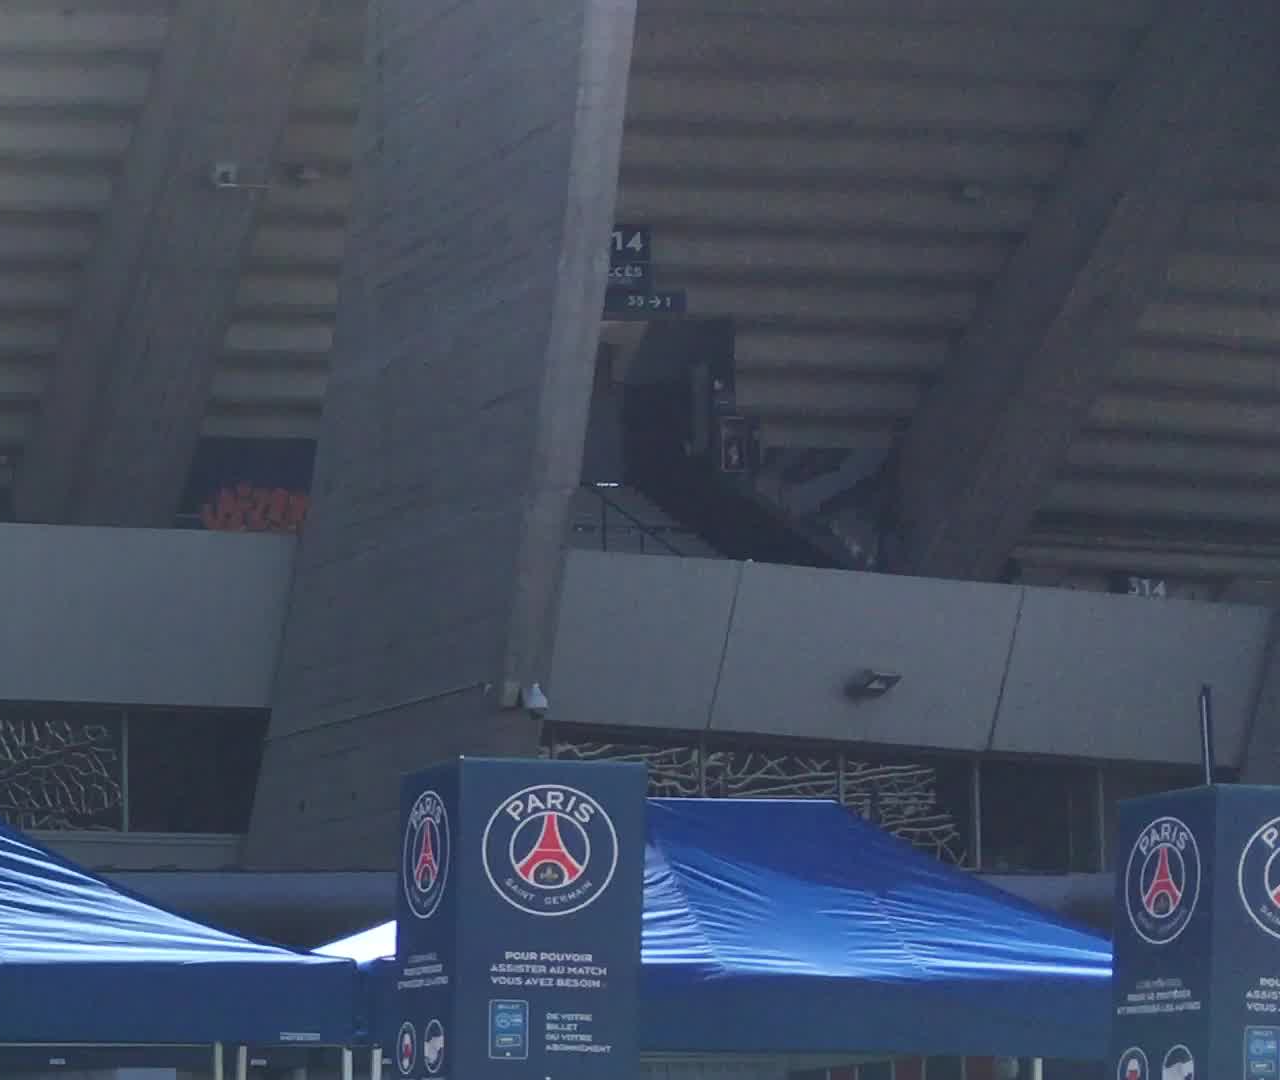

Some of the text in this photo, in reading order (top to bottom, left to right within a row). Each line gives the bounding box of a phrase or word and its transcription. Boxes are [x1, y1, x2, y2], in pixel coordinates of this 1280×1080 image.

[506, 791, 595, 825] PARIS
[1139, 823, 1189, 855] PARIS
[504, 877, 593, 905] SAINT GERMAIN
[505, 951, 593, 963] POUR POUVOIR
[489, 964, 607, 976] ASSISTER AU MATCH
[490, 976, 601, 988] VOUS AVEZ BESOIN
